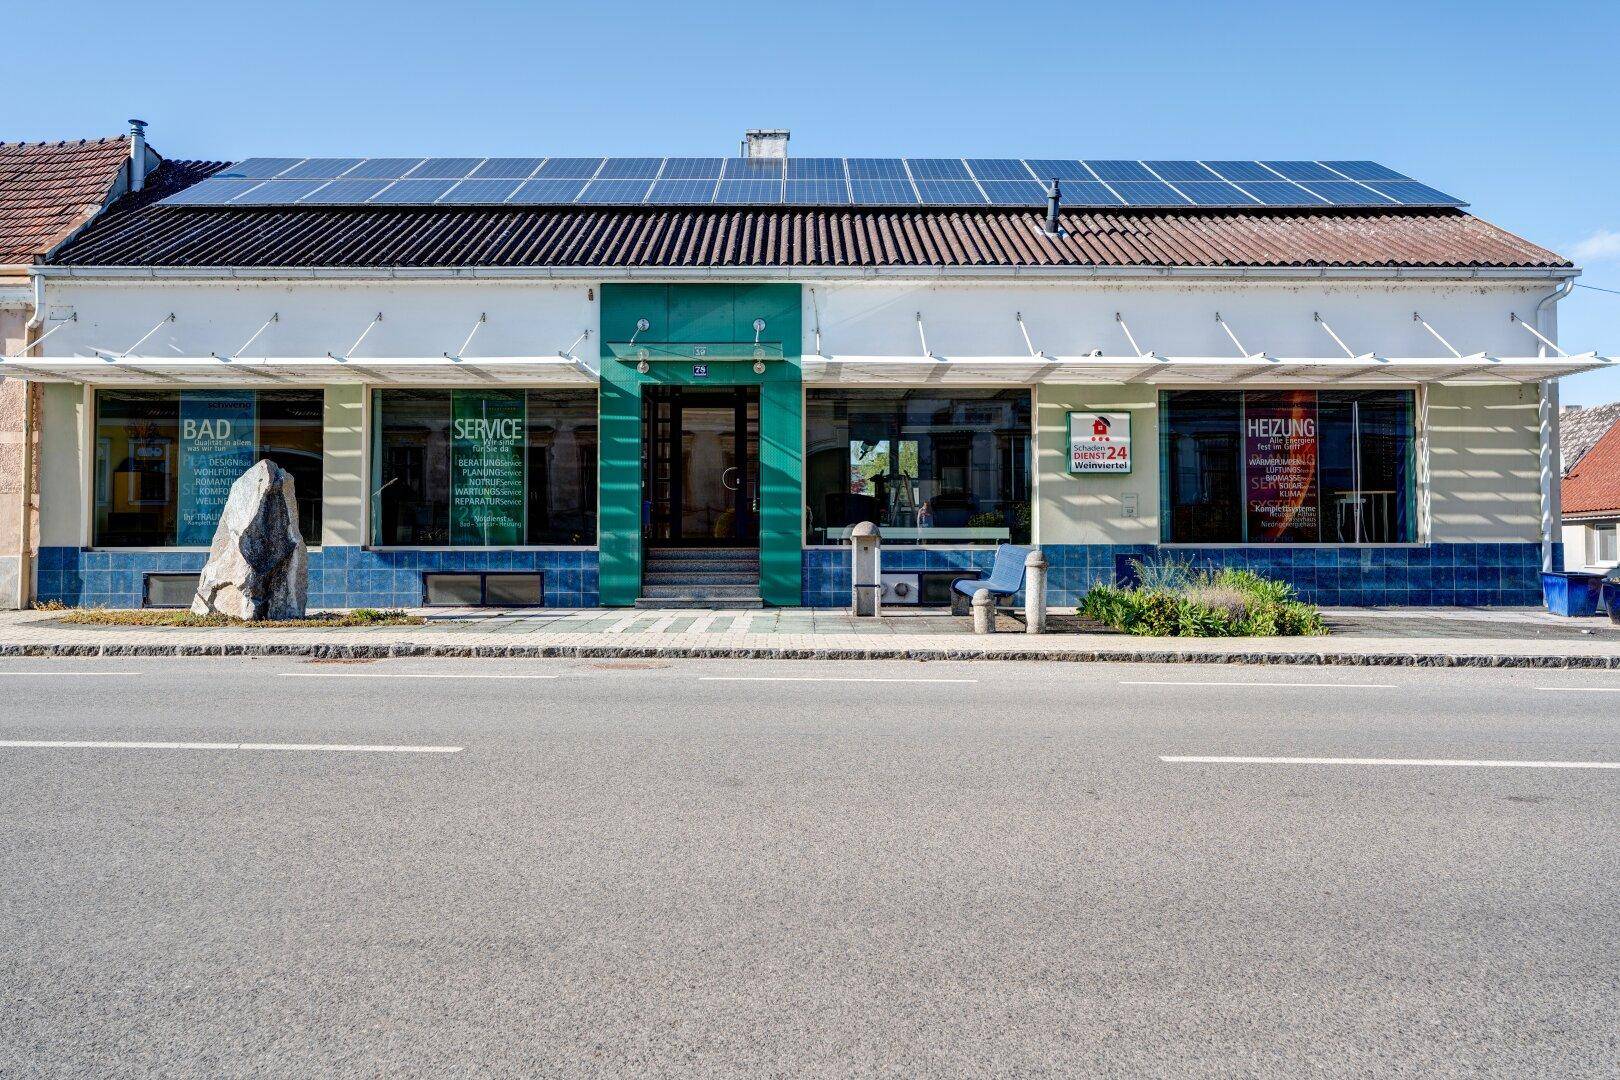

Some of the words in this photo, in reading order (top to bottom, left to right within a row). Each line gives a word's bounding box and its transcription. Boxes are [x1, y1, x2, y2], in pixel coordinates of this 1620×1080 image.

[184, 418, 231, 440] BAD
[454, 418, 522, 440] SERVICE
[1248, 418, 1315, 437] HEIZUNG
[1285, 436, 1315, 445] Energien
[1074, 444, 1106, 452] Schaden
[1074, 452, 1106, 460] DIENST
[1107, 446, 1127, 460] 24
[1074, 461, 1127, 469] Weinviertel
